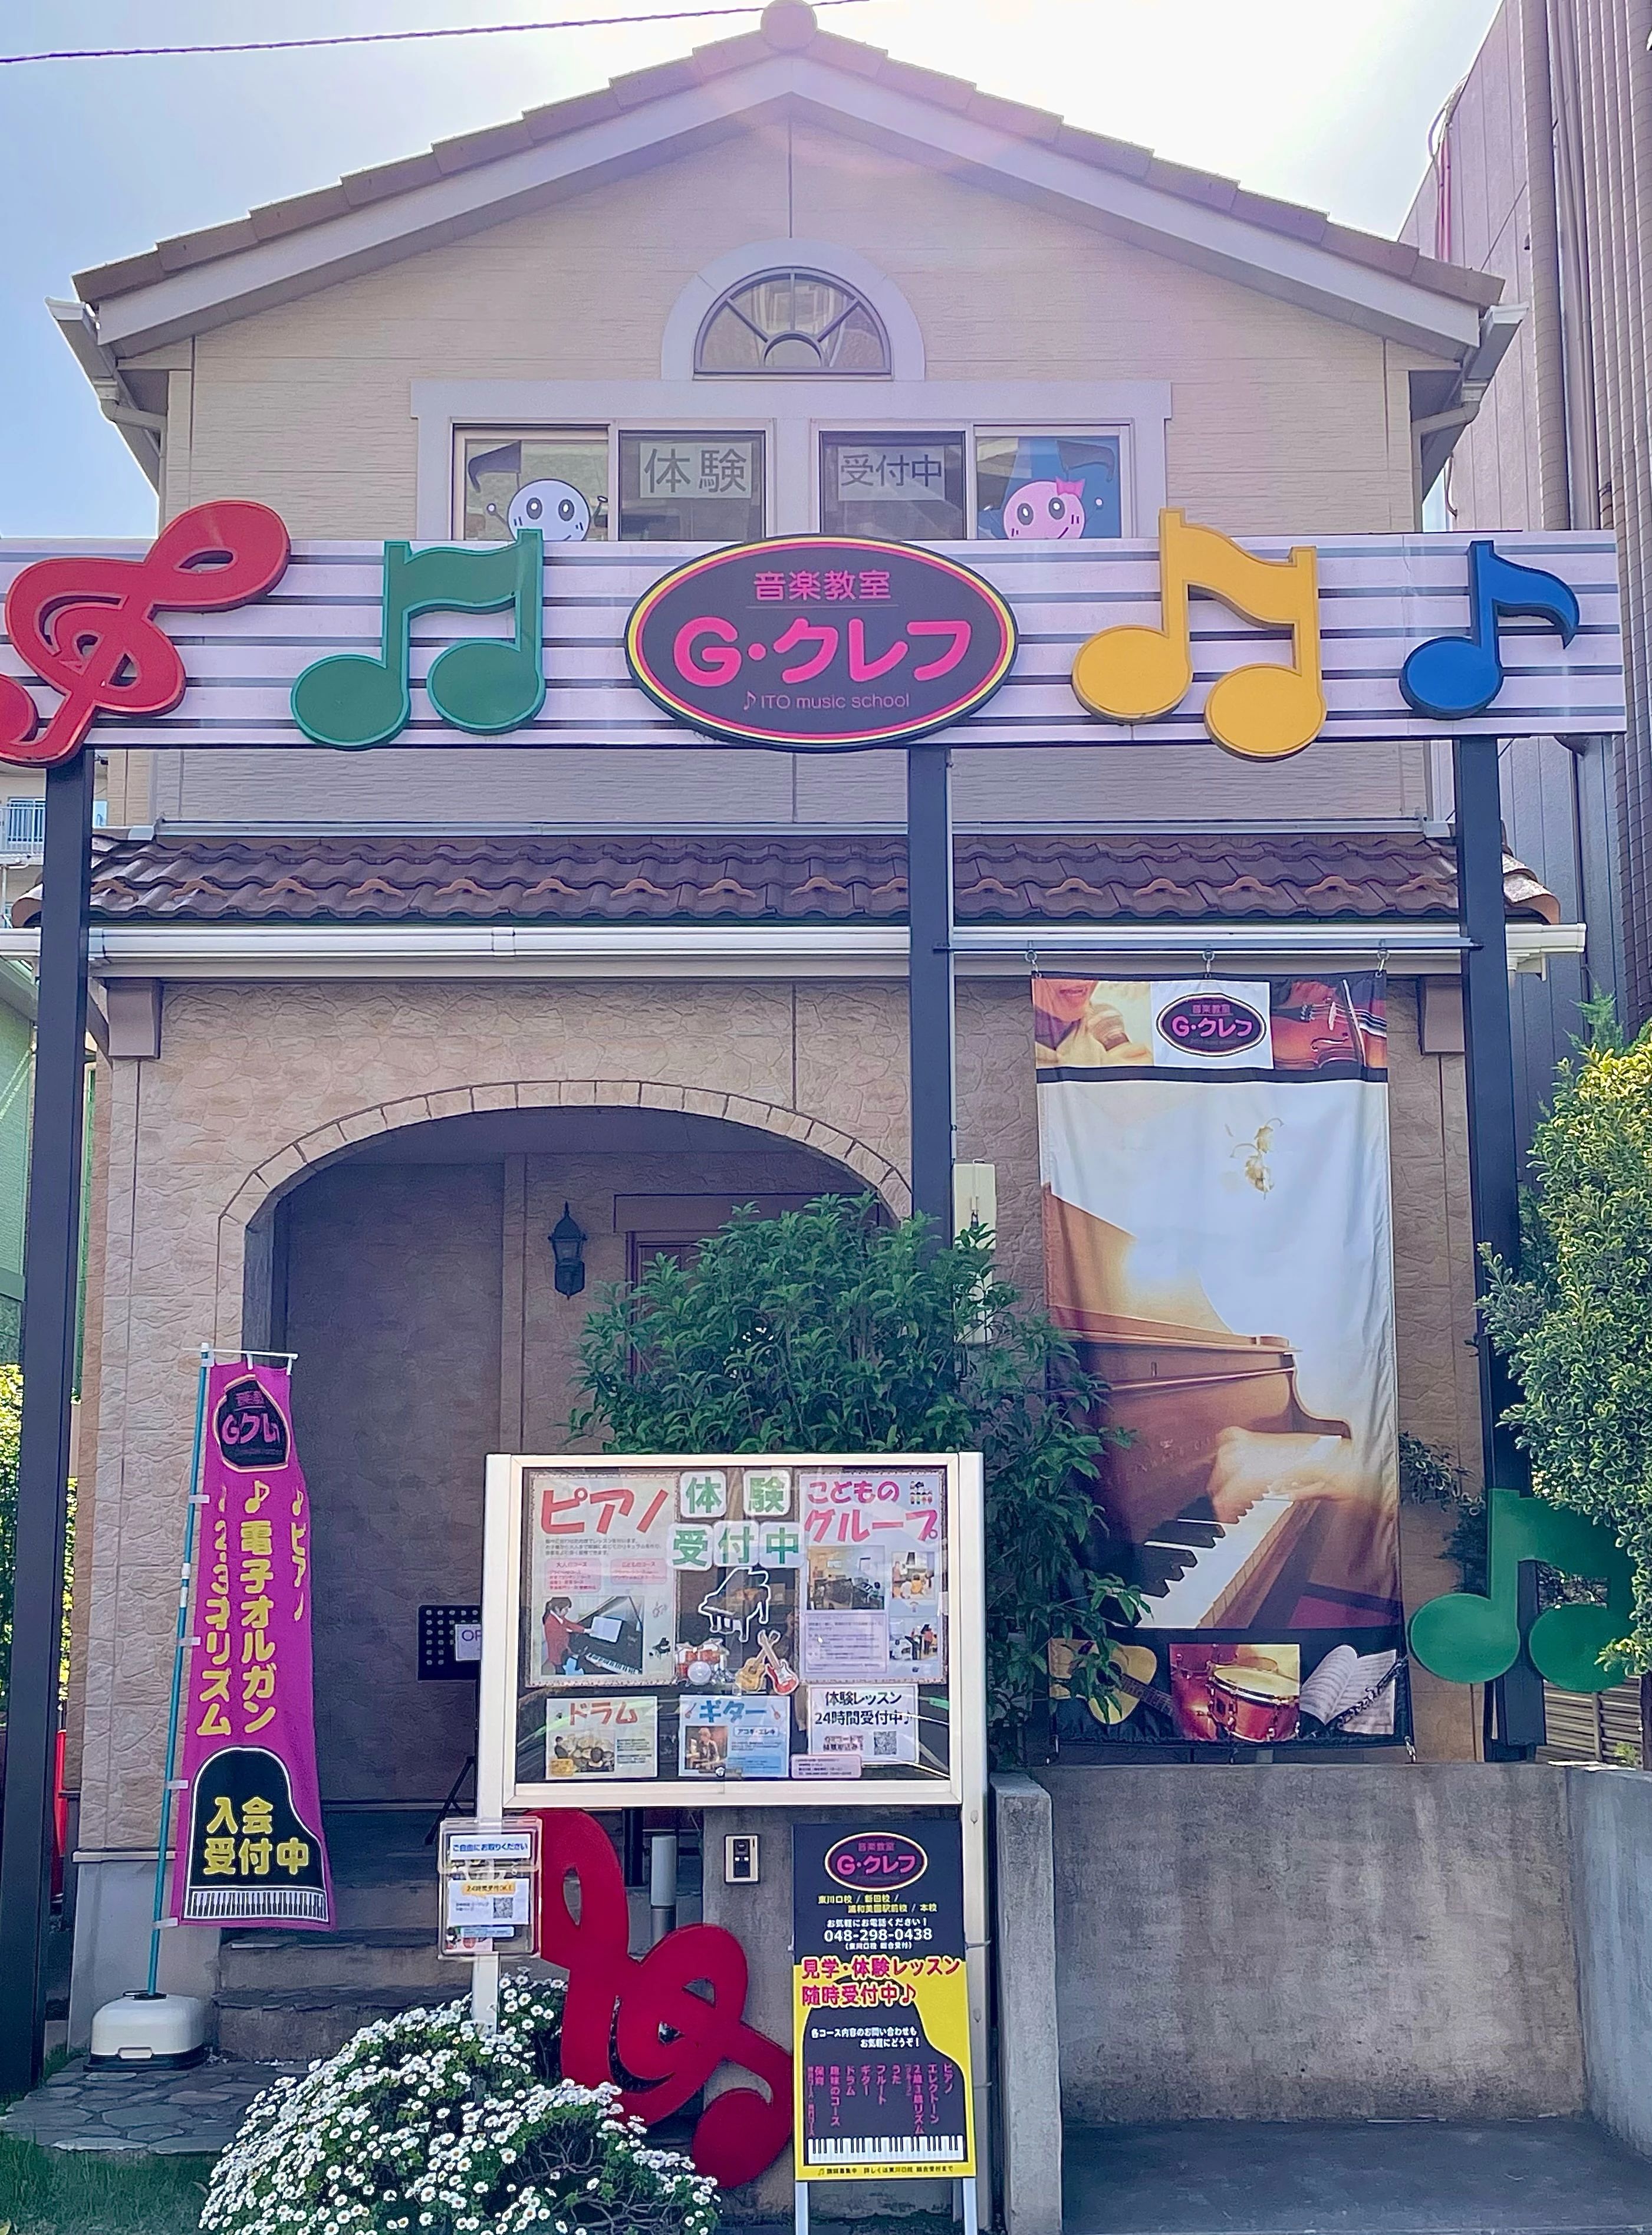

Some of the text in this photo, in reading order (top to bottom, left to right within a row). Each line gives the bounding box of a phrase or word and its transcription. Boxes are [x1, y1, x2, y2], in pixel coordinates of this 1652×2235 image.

[644, 448, 748, 493] 体験
[841, 454, 942, 487] 受付中
[753, 570, 891, 600] 音楽教室
[673, 616, 972, 686] G・クレフ
[761, 693, 909, 709] ITO music school
[686, 1477, 785, 1514] 体験
[808, 1481, 899, 1503] こどもの
[541, 1487, 669, 1534] ピアノ
[804, 1509, 938, 1543] グループ
[672, 1527, 799, 1567] 受付中
[239, 1520, 277, 1733] 電子オルガン
[570, 1701, 638, 1725] ドラム
[699, 1700, 766, 1723] ギター
[825, 1691, 902, 1706] 体験レッスン
[206, 1797, 274, 1835] 入会
[203, 1837, 310, 1876] 受付中
[837, 1855, 916, 1875] G・クレフ
[824, 1928, 933, 1943] 048-298-0438
[802, 1957, 960, 1979] 見学・体験レッスン
[845, 2066, 855, 2096] ドラム
[861, 2065, 871, 2096] ギター
[877, 2065, 887, 2105] フルート
[928, 2064, 939, 2124] エレクトーン
